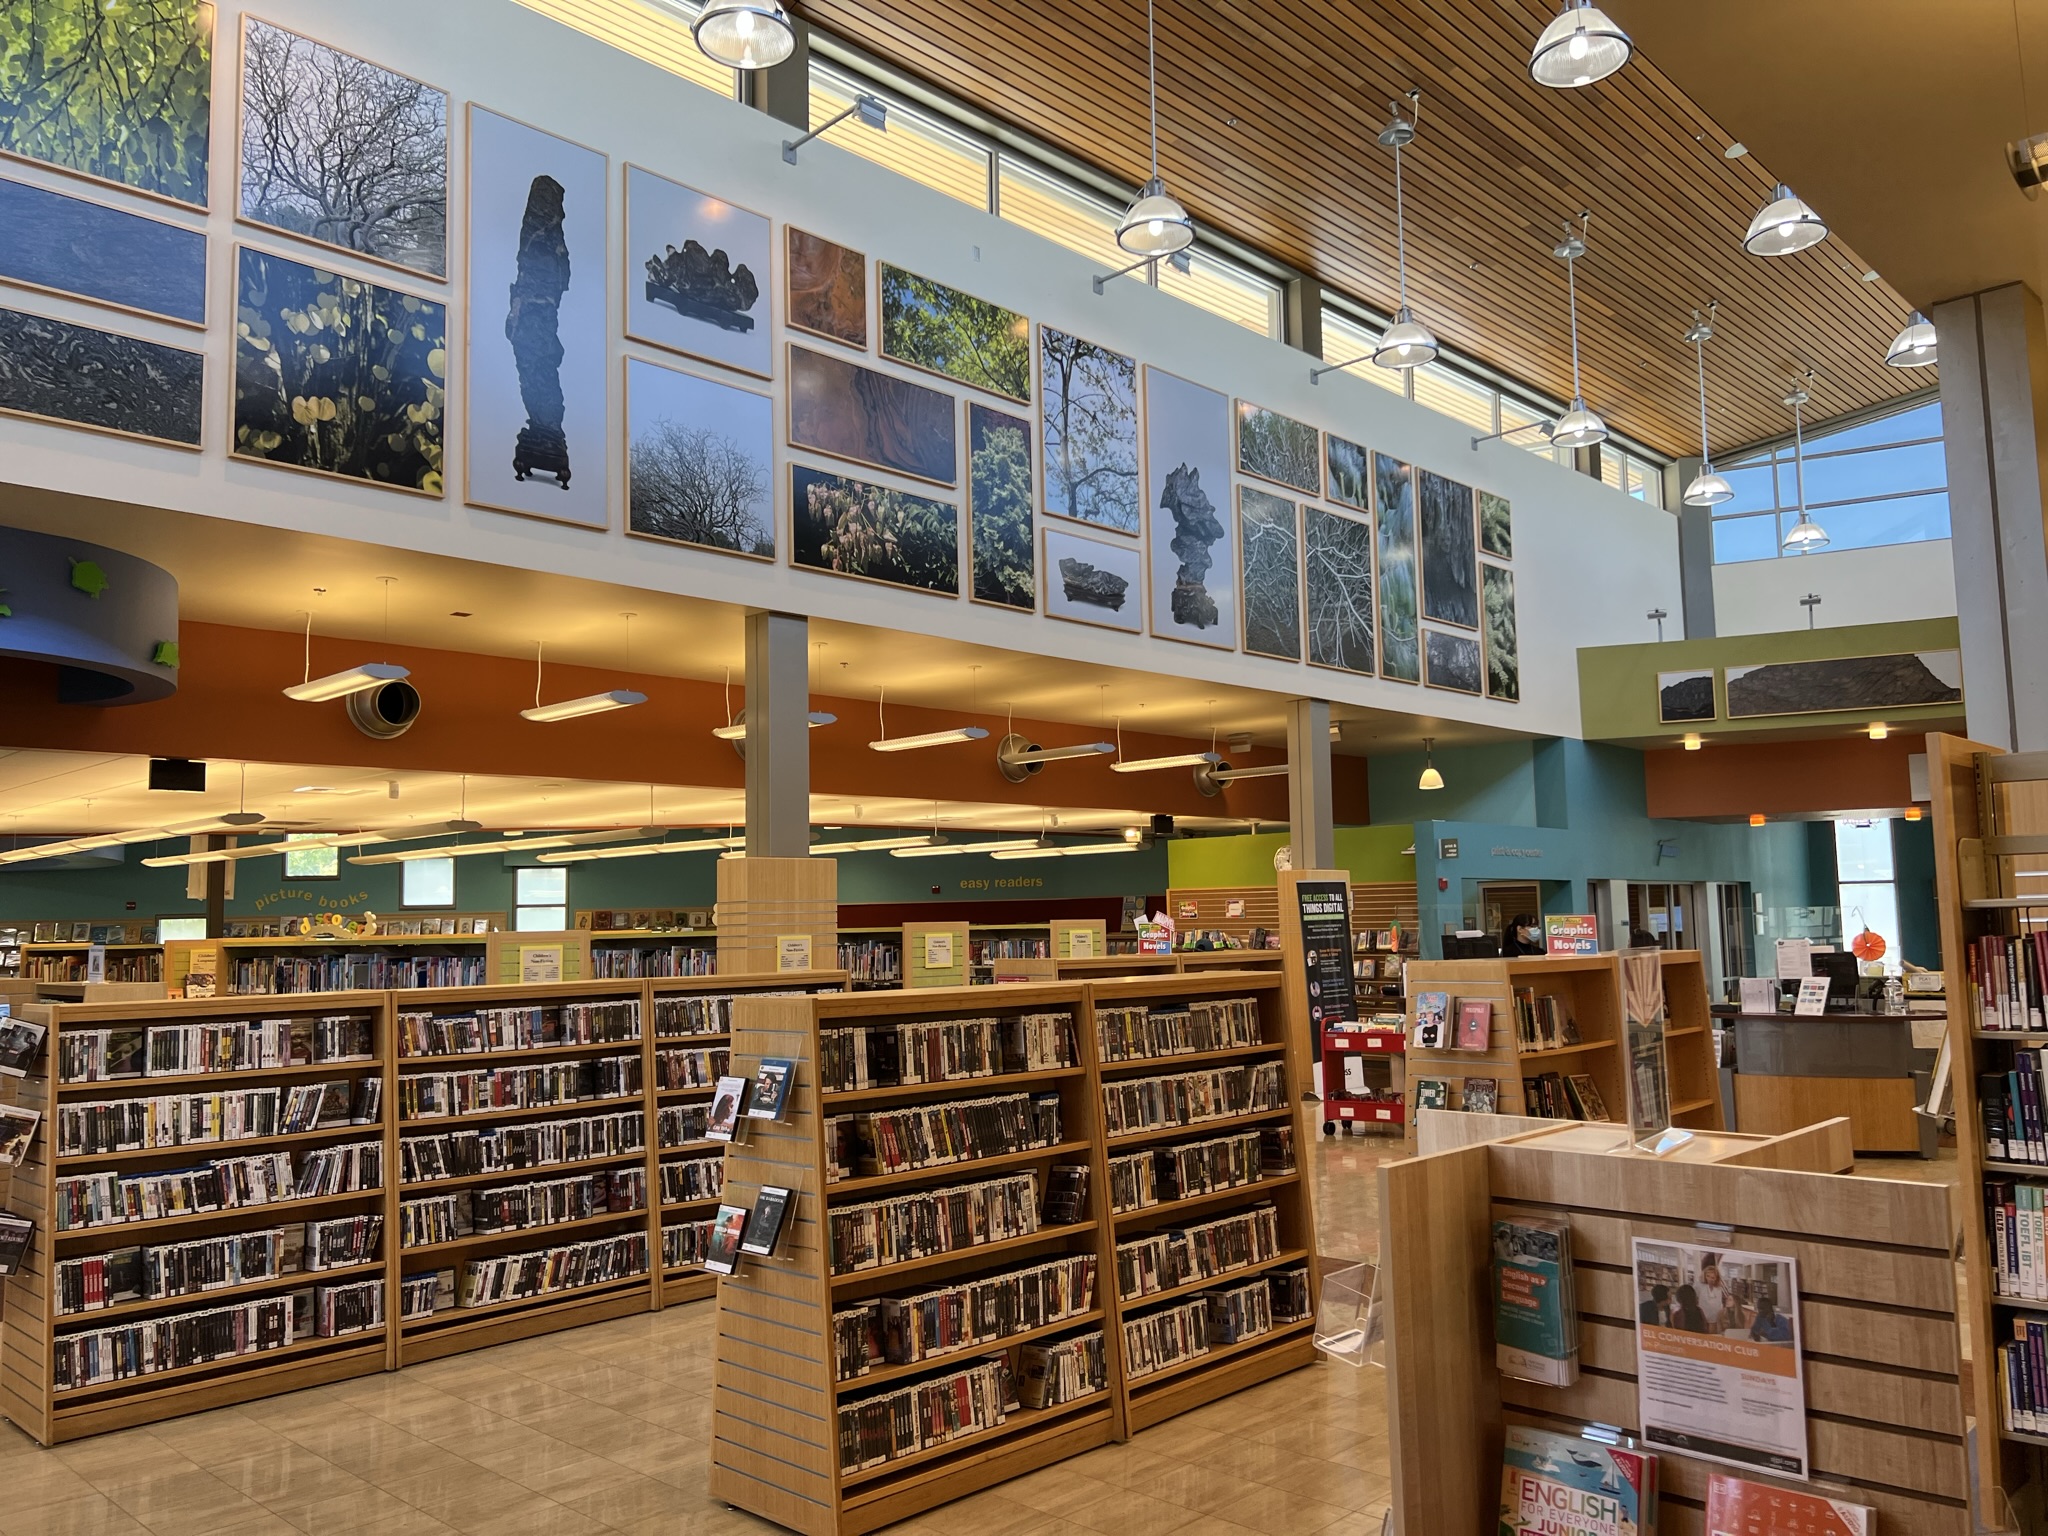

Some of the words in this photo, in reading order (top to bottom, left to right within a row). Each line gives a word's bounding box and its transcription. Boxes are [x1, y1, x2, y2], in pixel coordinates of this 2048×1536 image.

[960, 879, 990, 891] easy
[995, 876, 1043, 888] readers
[255, 888, 313, 911] picture
[318, 891, 368, 908] books
[1302, 894, 1313, 902] FREE
[1313, 894, 1329, 902] ACCESS
[1329, 893, 1335, 901] TO
[1335, 893, 1343, 901] ALL
[1302, 903, 1323, 913] THINGS
[1323, 903, 1344, 913] DIGITAL
[300, 912, 365, 935] discover
[1550, 923, 1593, 936] Graphic
[1141, 929, 1168, 940] Graphic
[1143, 941, 1166, 950] Novels
[1553, 940, 1591, 950] Novels
[1468, 1083, 1495, 1093] DEAD
[1996, 1210, 2004, 1232] IELTS
[2020, 1213, 2030, 1247] TOEFL
[2034, 1215, 2043, 1243] TOEFL
[2021, 1251, 2032, 1268] iBT
[1503, 1268, 1529, 1282] English
[1530, 1277, 1539, 1285] as
[1502, 1280, 1529, 1294] Second
[1502, 1293, 1537, 1308] Language
[1643, 1329, 1657, 1339] ELL
[1658, 1332, 1732, 1352] CONVERSATION
[1734, 1345, 1759, 1357] CLUB
[1741, 1373, 1777, 1386] SUNDAYS
[1520, 1501, 1544, 1516] FOR
[1521, 1478, 1617, 1524] ENGLISH
[1549, 1508, 1616, 1536] EVERYONE
